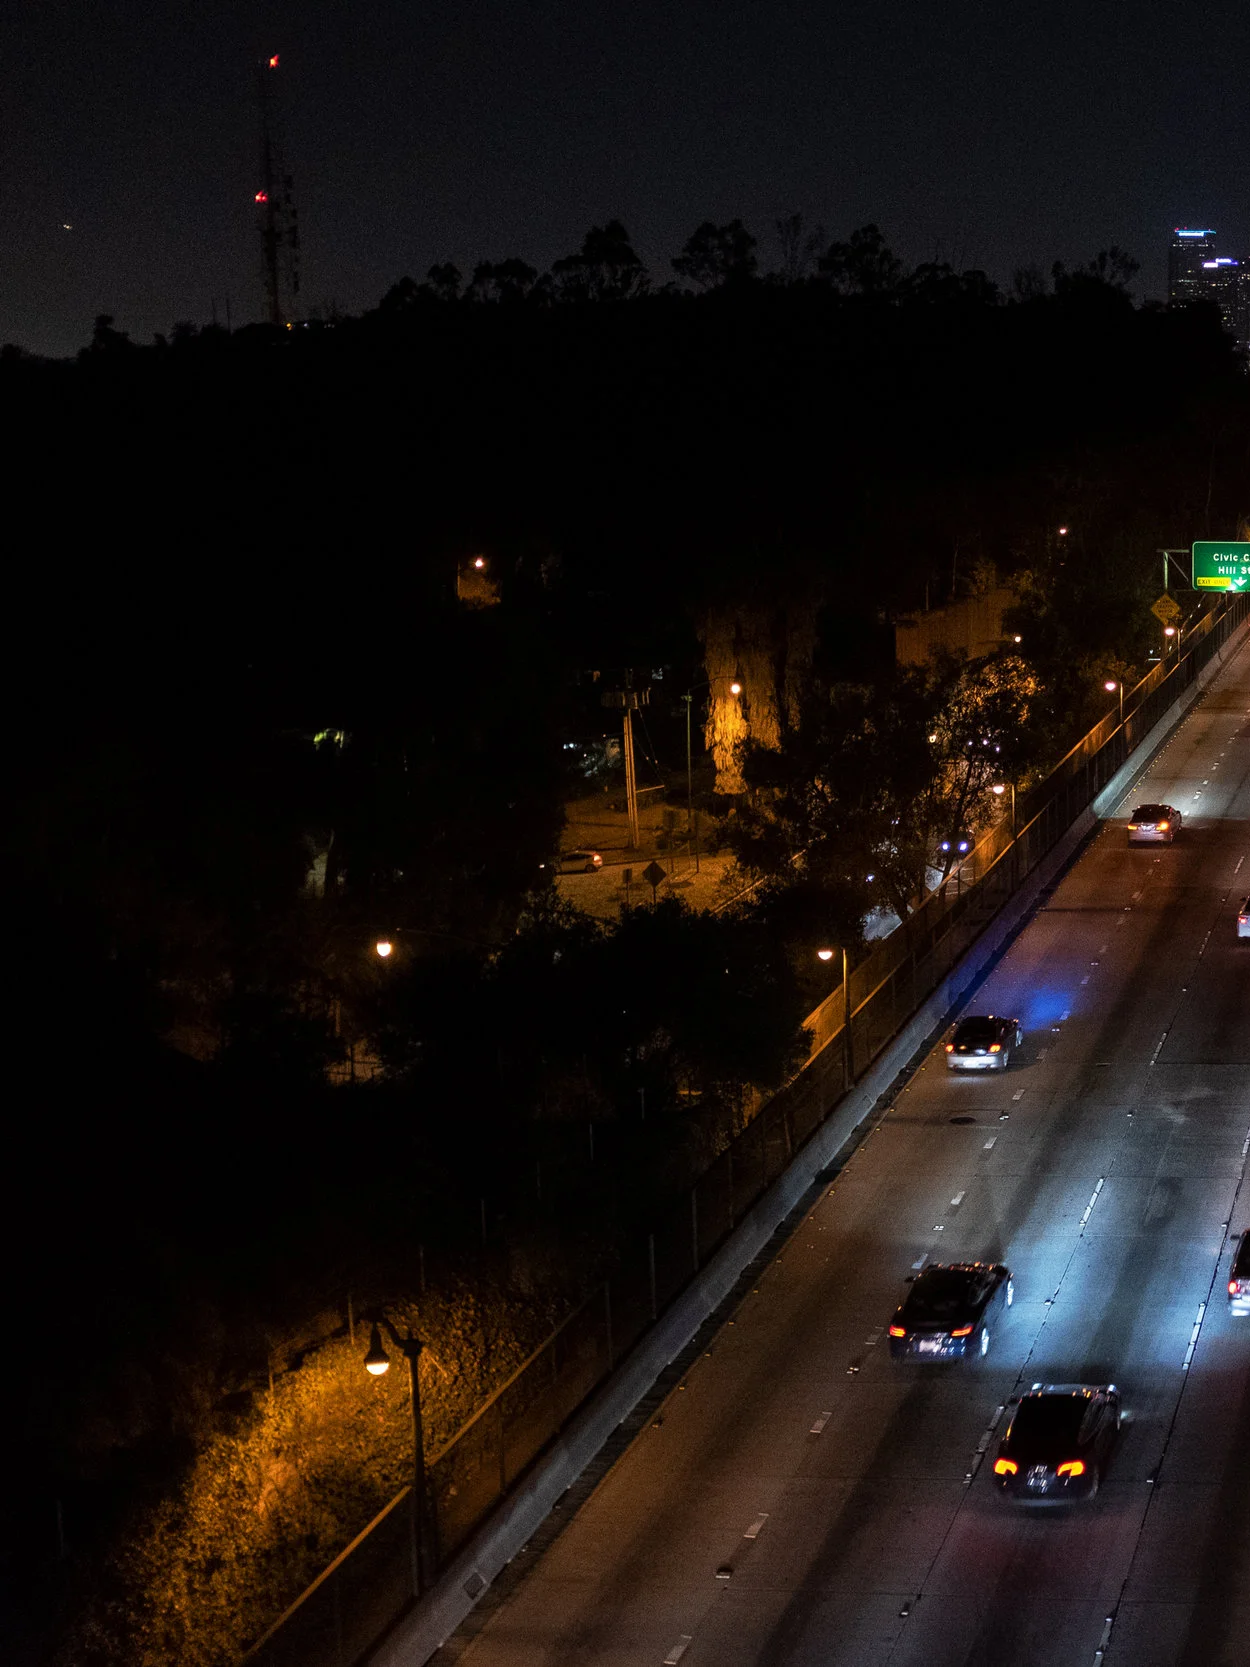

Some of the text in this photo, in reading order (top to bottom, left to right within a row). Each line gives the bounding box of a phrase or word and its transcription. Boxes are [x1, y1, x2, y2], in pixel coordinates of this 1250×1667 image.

[1213, 553, 1238, 561] Civic
[1218, 566, 1236, 574] Hill
[1197, 577, 1211, 585] EXIT
